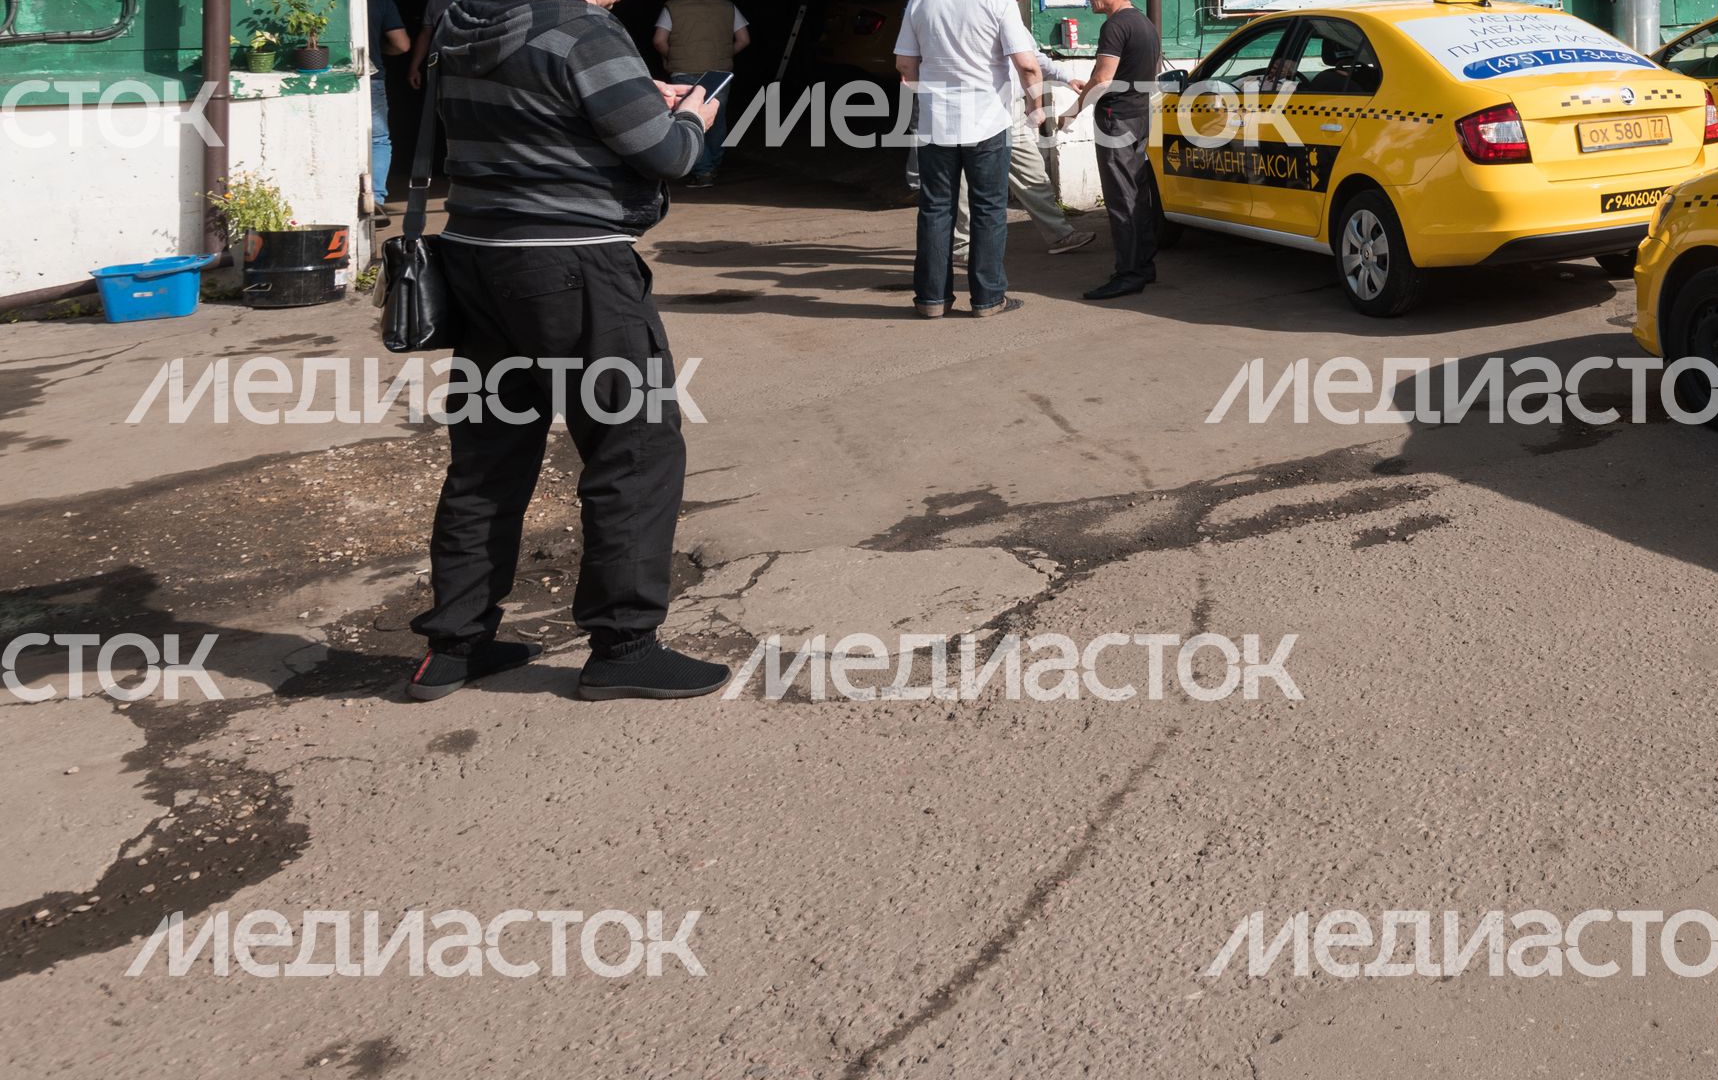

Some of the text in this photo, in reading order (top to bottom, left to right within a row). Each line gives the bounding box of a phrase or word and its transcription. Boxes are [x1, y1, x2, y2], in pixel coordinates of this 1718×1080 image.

[1470, 23, 1576, 38] МЕХАНИК
[1448, 33, 1550, 58] ПУТЕВЫЕ
[1486, 52, 1544, 73] (495)
[1614, 121, 1643, 141] 580
[1650, 119, 1664, 133] 77
[1185, 147, 1246, 175] РЕЗИДЕНТ
[1251, 153, 1298, 179] ТАКСИ
